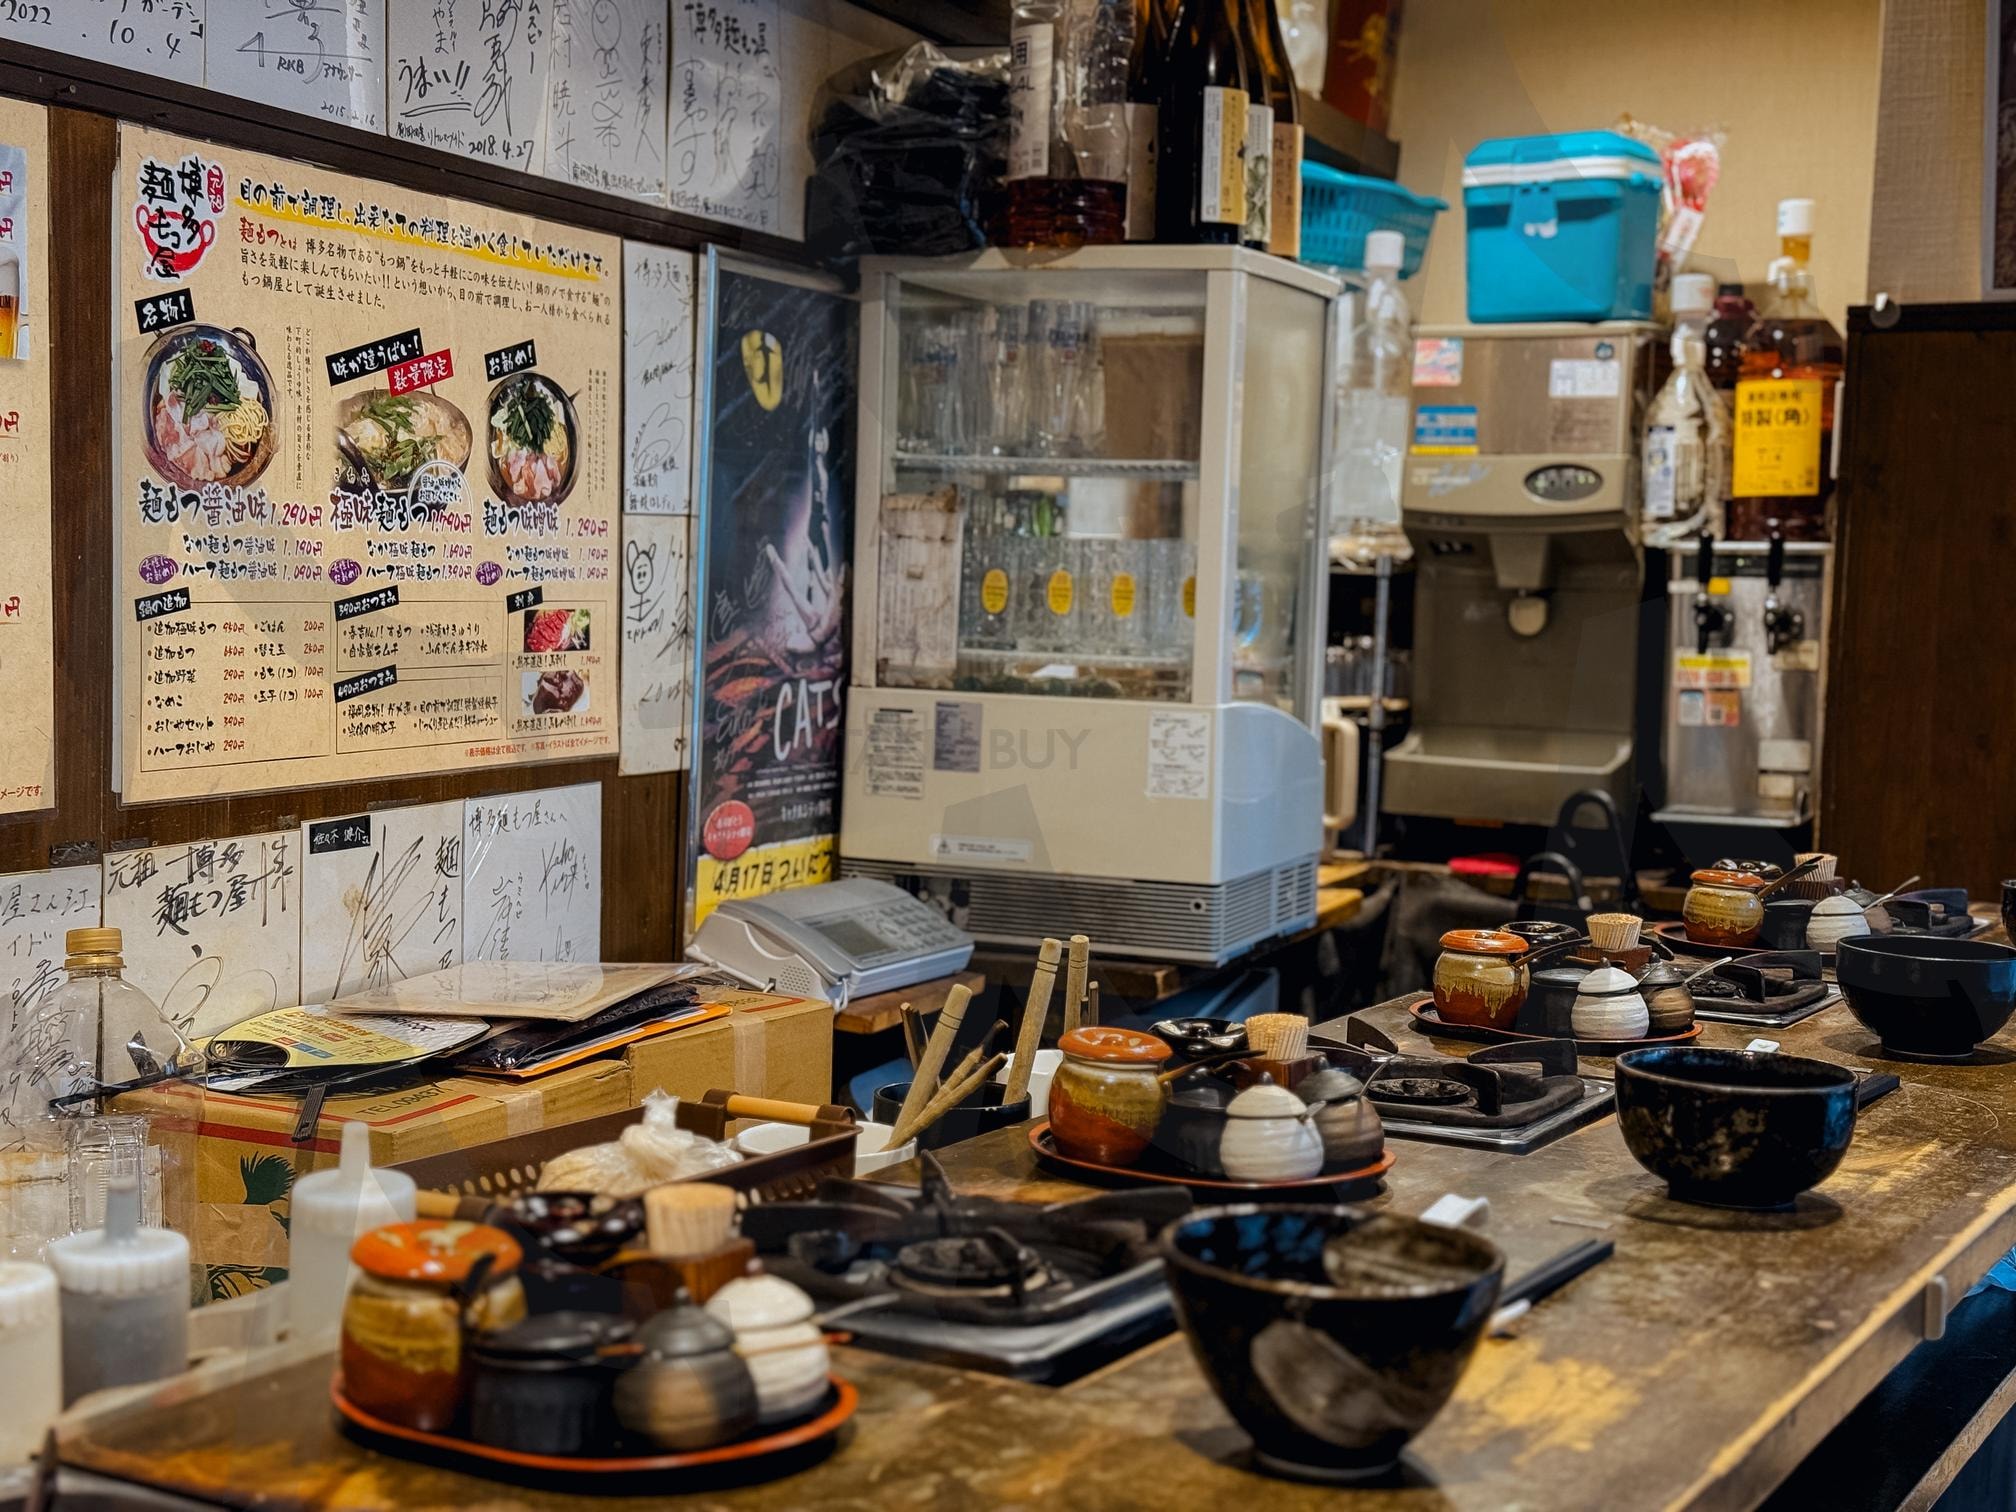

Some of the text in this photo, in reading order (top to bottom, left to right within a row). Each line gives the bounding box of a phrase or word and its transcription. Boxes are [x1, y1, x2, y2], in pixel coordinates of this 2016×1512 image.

[277, 56, 304, 74] RKB
[468, 134, 534, 172] 2018.4.27
[142, 295, 188, 329] 名物!
[394, 356, 448, 392] 数量限定
[139, 478, 269, 526] 麺もつ醤油味
[330, 487, 428, 532] 極味麺もつ
[482, 499, 559, 537] 麺もつ味噌味
[138, 592, 188, 617] 鍋の追加
[338, 590, 397, 616] 390円おつまみ
[258, 620, 286, 633] ごはん
[303, 620, 325, 632] 200円
[154, 645, 196, 660] 追加もつ
[258, 643, 286, 657] 替え玉
[154, 668, 197, 684] 追加野菜
[223, 669, 245, 681] 290円
[303, 664, 325, 677] 100円
[154, 694, 183, 709] なめこ
[223, 692, 245, 705] 290円
[303, 687, 325, 700] 100円
[774, 676, 841, 761] CATS
[223, 739, 245, 752] 290円
[713, 861, 774, 896] 4月17日
